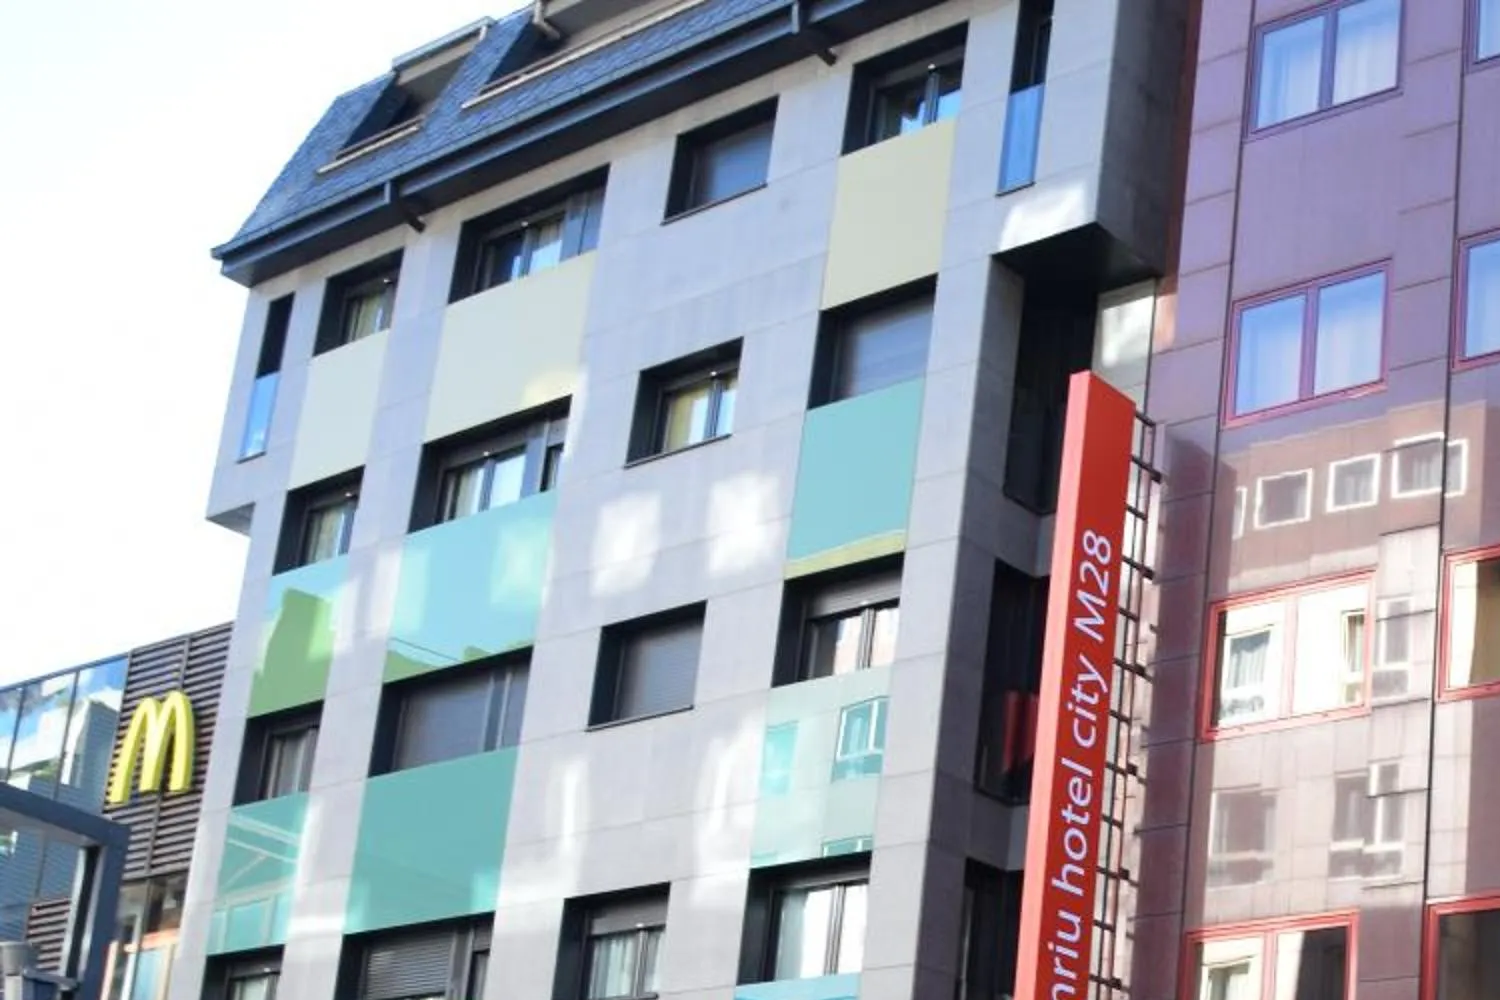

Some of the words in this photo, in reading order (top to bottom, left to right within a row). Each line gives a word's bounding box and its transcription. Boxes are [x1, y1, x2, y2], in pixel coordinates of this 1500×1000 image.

[1073, 529, 1112, 641] M28
[1068, 655, 1107, 747] city
[1052, 757, 1092, 896] hotel
